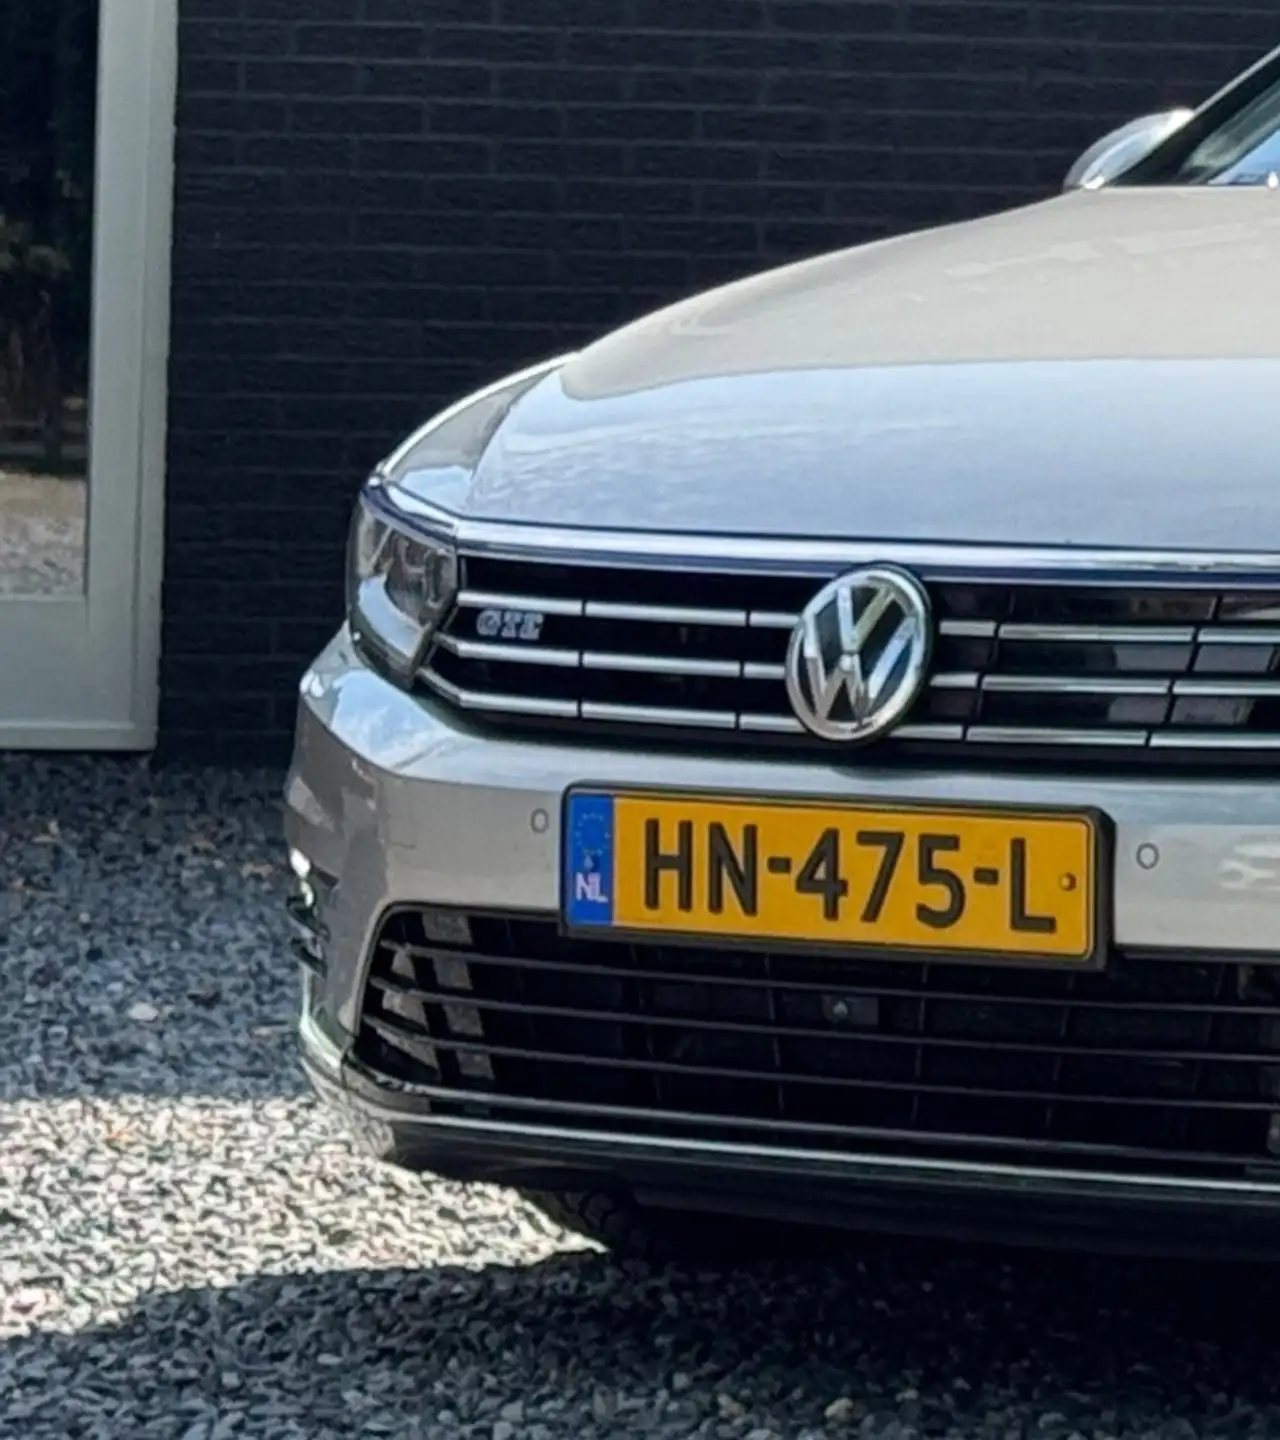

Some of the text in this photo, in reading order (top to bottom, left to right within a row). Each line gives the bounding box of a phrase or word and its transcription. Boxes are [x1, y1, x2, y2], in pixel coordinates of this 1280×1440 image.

[475, 608, 544, 641] GTE
[574, 872, 609, 903] NL
[644, 817, 1057, 934] HN-475-L
